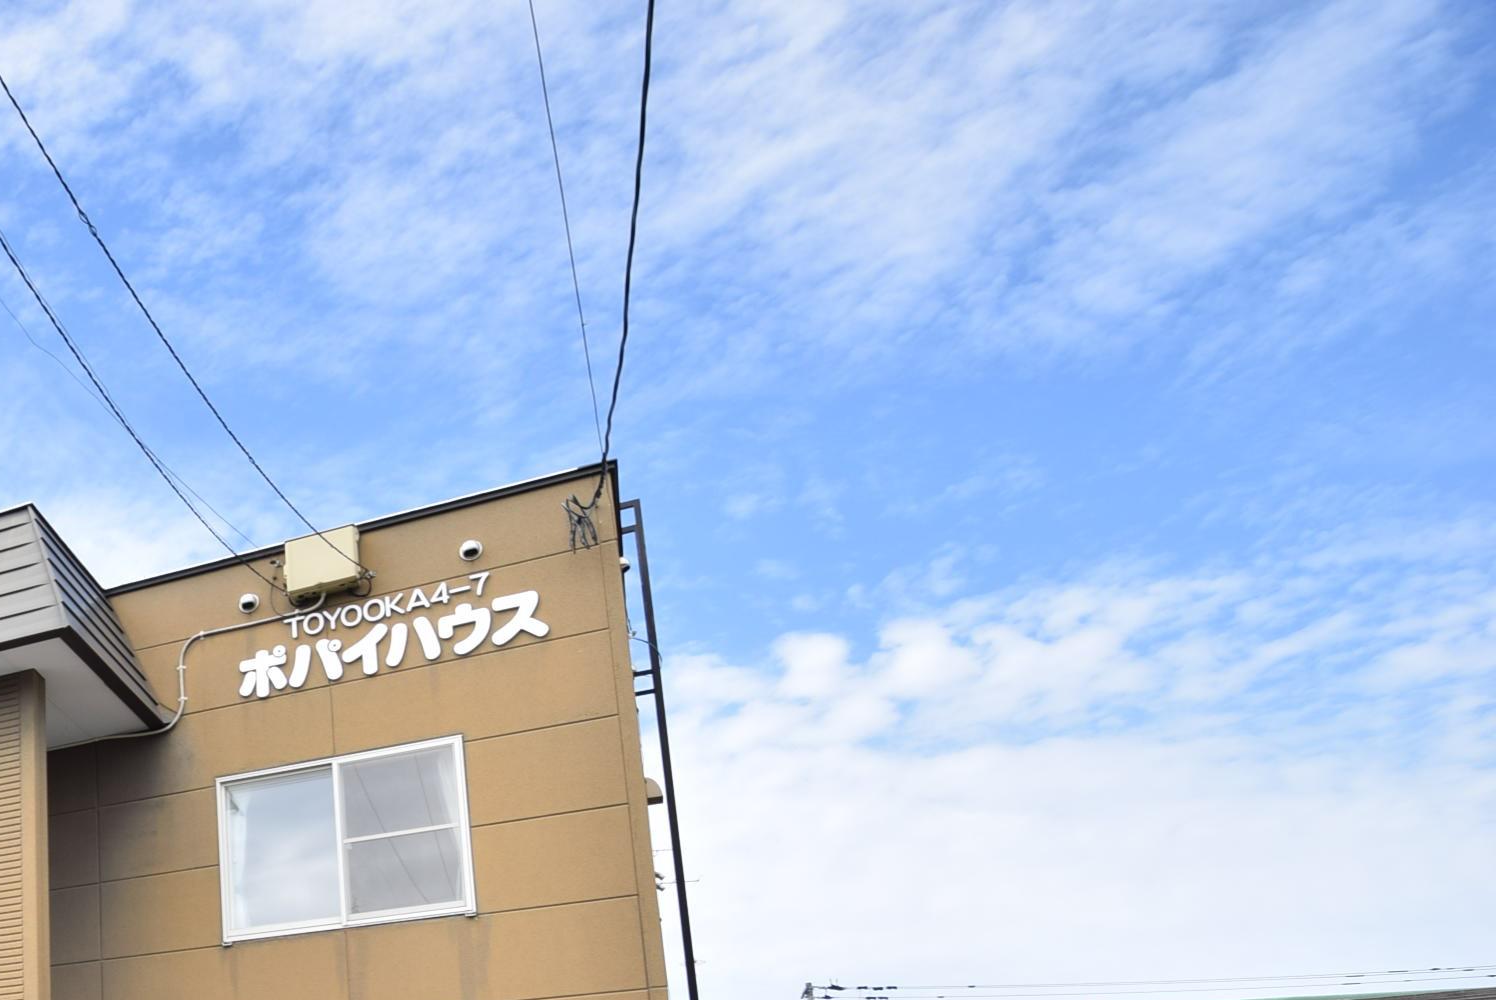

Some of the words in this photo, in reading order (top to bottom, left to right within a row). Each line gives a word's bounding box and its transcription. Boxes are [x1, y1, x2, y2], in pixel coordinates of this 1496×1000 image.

[239, 590, 550, 699] ポパイハウス
